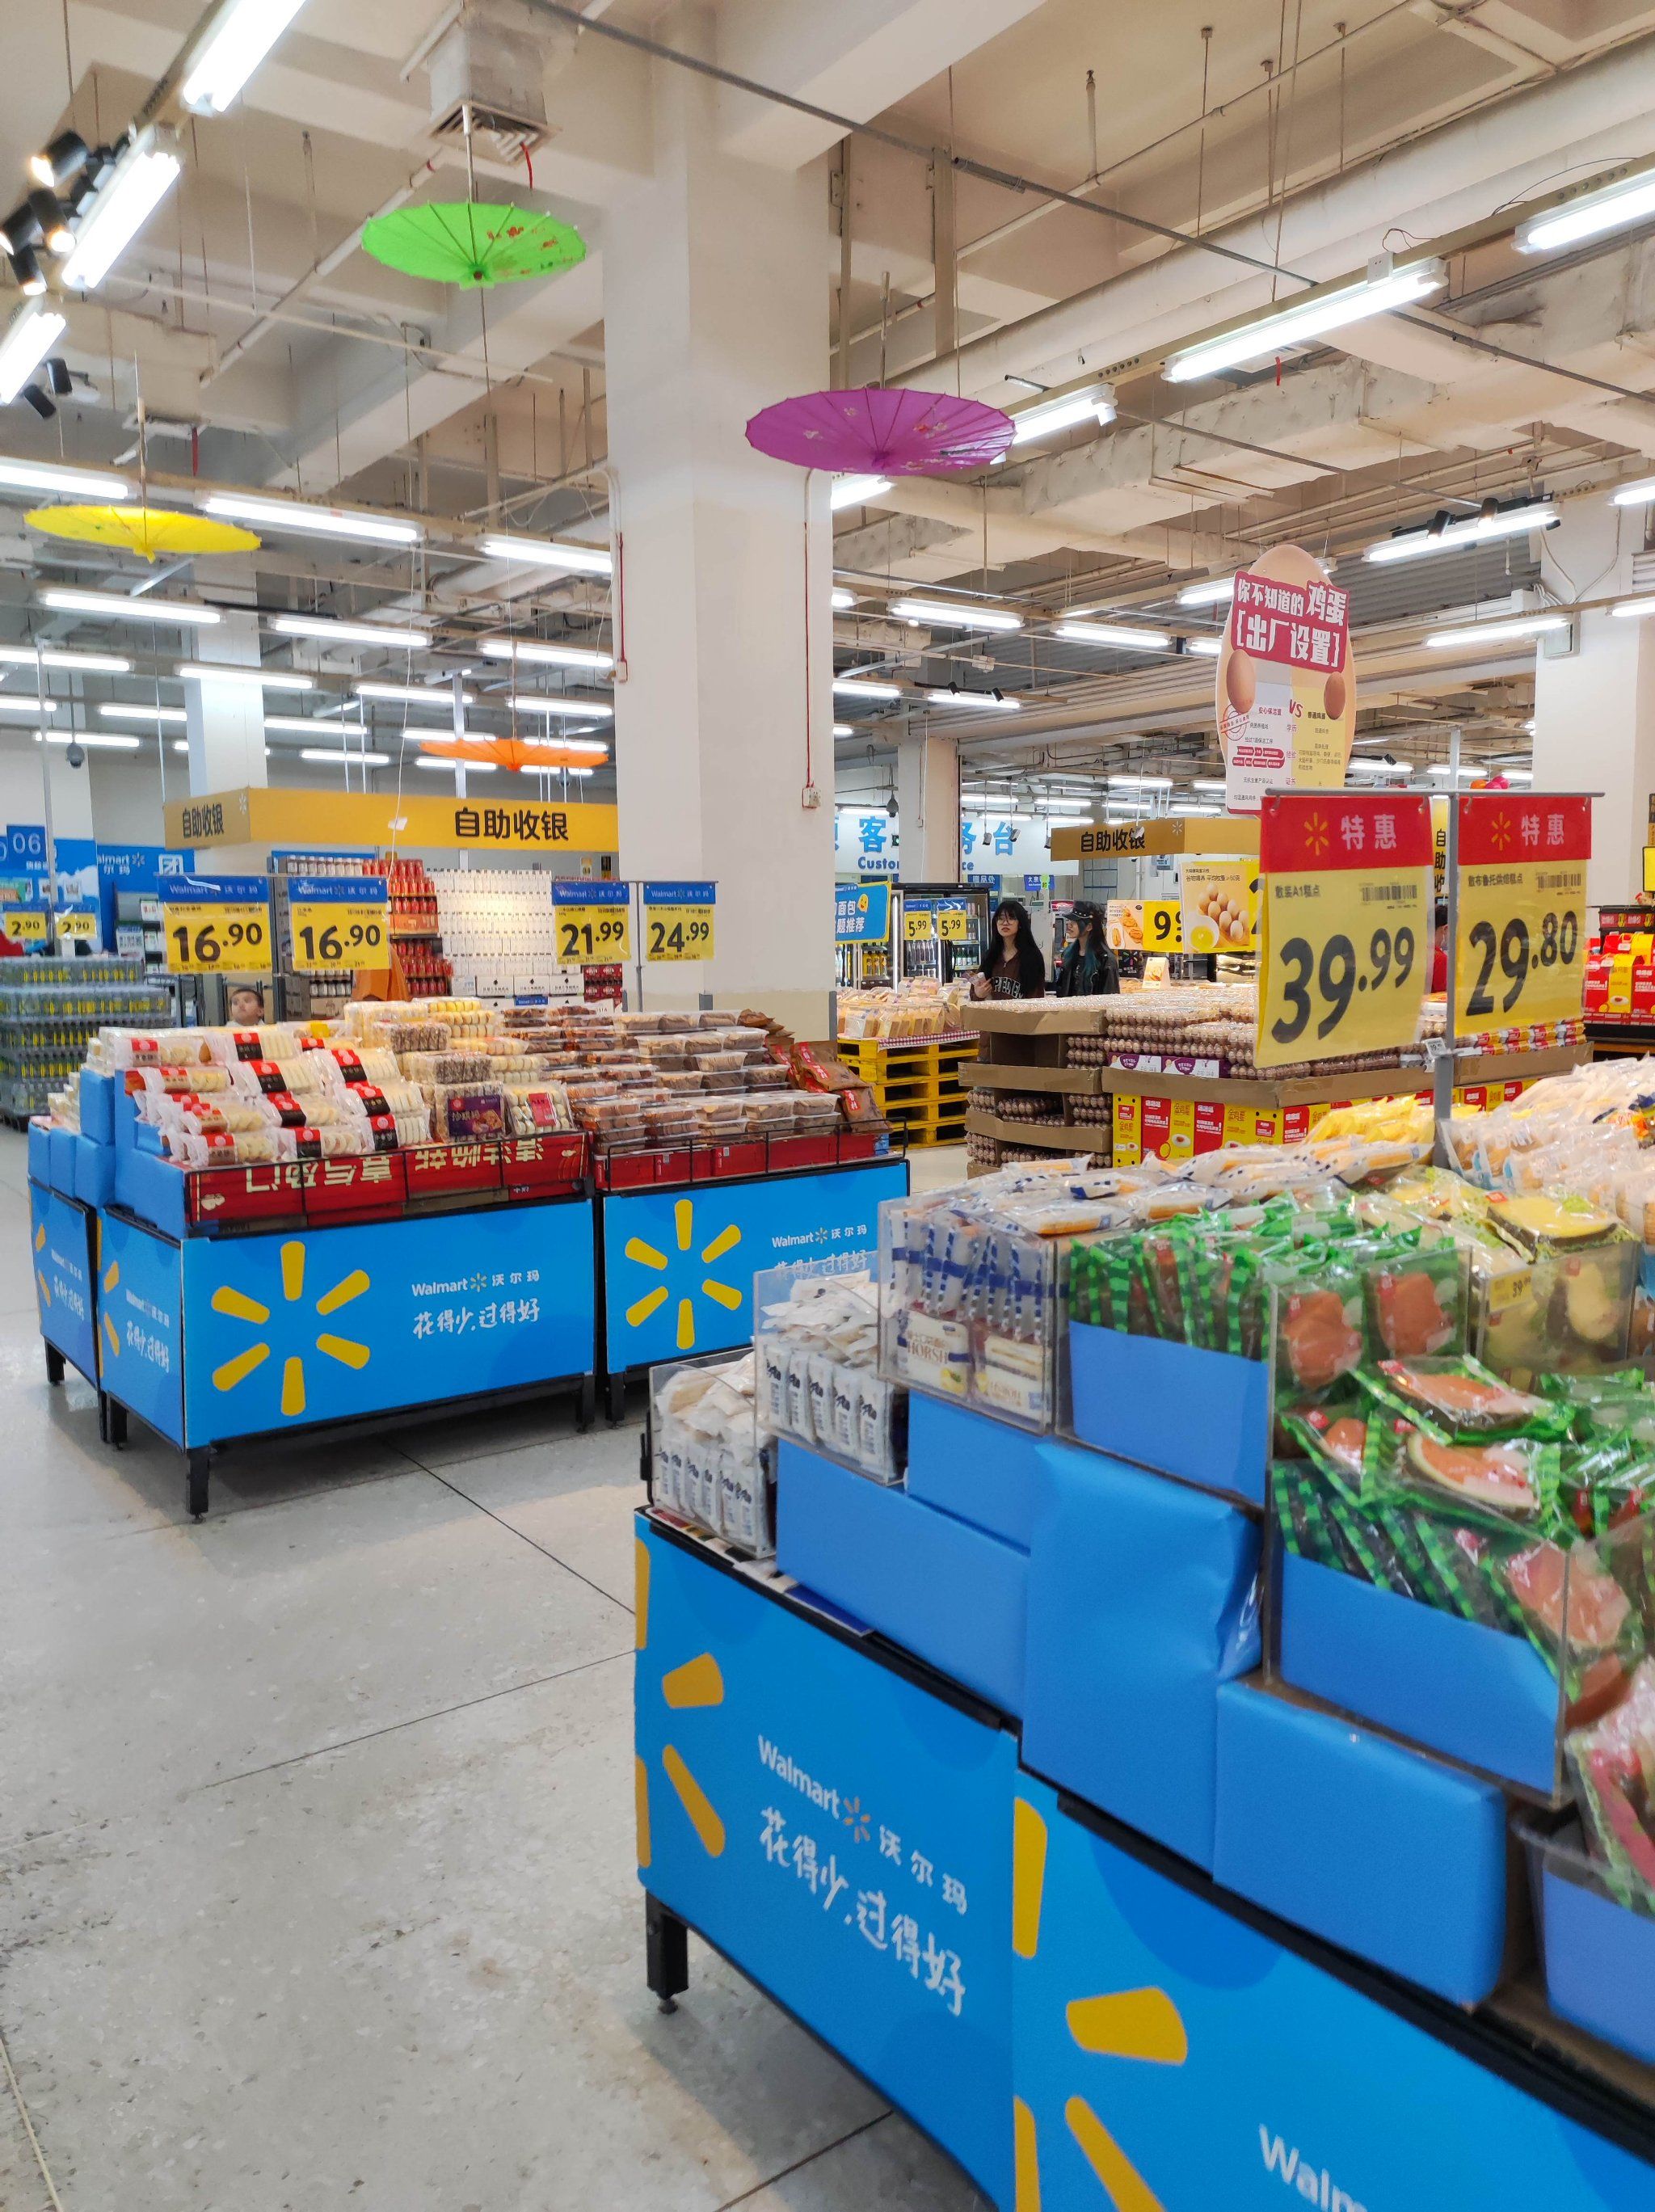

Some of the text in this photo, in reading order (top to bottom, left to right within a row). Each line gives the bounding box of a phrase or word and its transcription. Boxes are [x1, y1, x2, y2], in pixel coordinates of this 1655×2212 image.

[1237, 578, 1347, 626] 你不知道的鸡蛋
[1289, 698, 1303, 718] VS
[182, 803, 225, 839] 自助收银
[455, 807, 569, 841] 自助收银
[1341, 813, 1397, 851] 特惠
[1521, 814, 1564, 847] 特惠
[12, 832, 41, 854] 06
[1080, 828, 1146, 853] 自助收银
[96, 853, 130, 865] almart
[103, 865, 131, 876] 尔玛
[857, 857, 899, 870] Custo
[169, 884, 208, 895] Walmart
[297, 884, 333, 895] Walmart
[558, 890, 587, 898] Walmart
[651, 890, 676, 898] Walmart
[835, 900, 857, 916] 面包
[11, 921, 40, 936] 2.90
[836, 916, 865, 933] 题推荐
[908, 920, 927, 937] 5.99
[941, 919, 961, 937] 5.99
[172, 923, 263, 963] 16.90
[299, 924, 381, 960] 16.90
[561, 921, 625, 957] 21.99
[650, 921, 710, 954] 24.99
[1465, 909, 1578, 1017] 29.80
[1271, 926, 1416, 1044] 39.99
[772, 1224, 868, 1249] Walmart 沃尔玛
[411, 1269, 540, 1297] Walmart 沃尔玛
[758, 1733, 968, 1915] Walmart 沃尔玛
